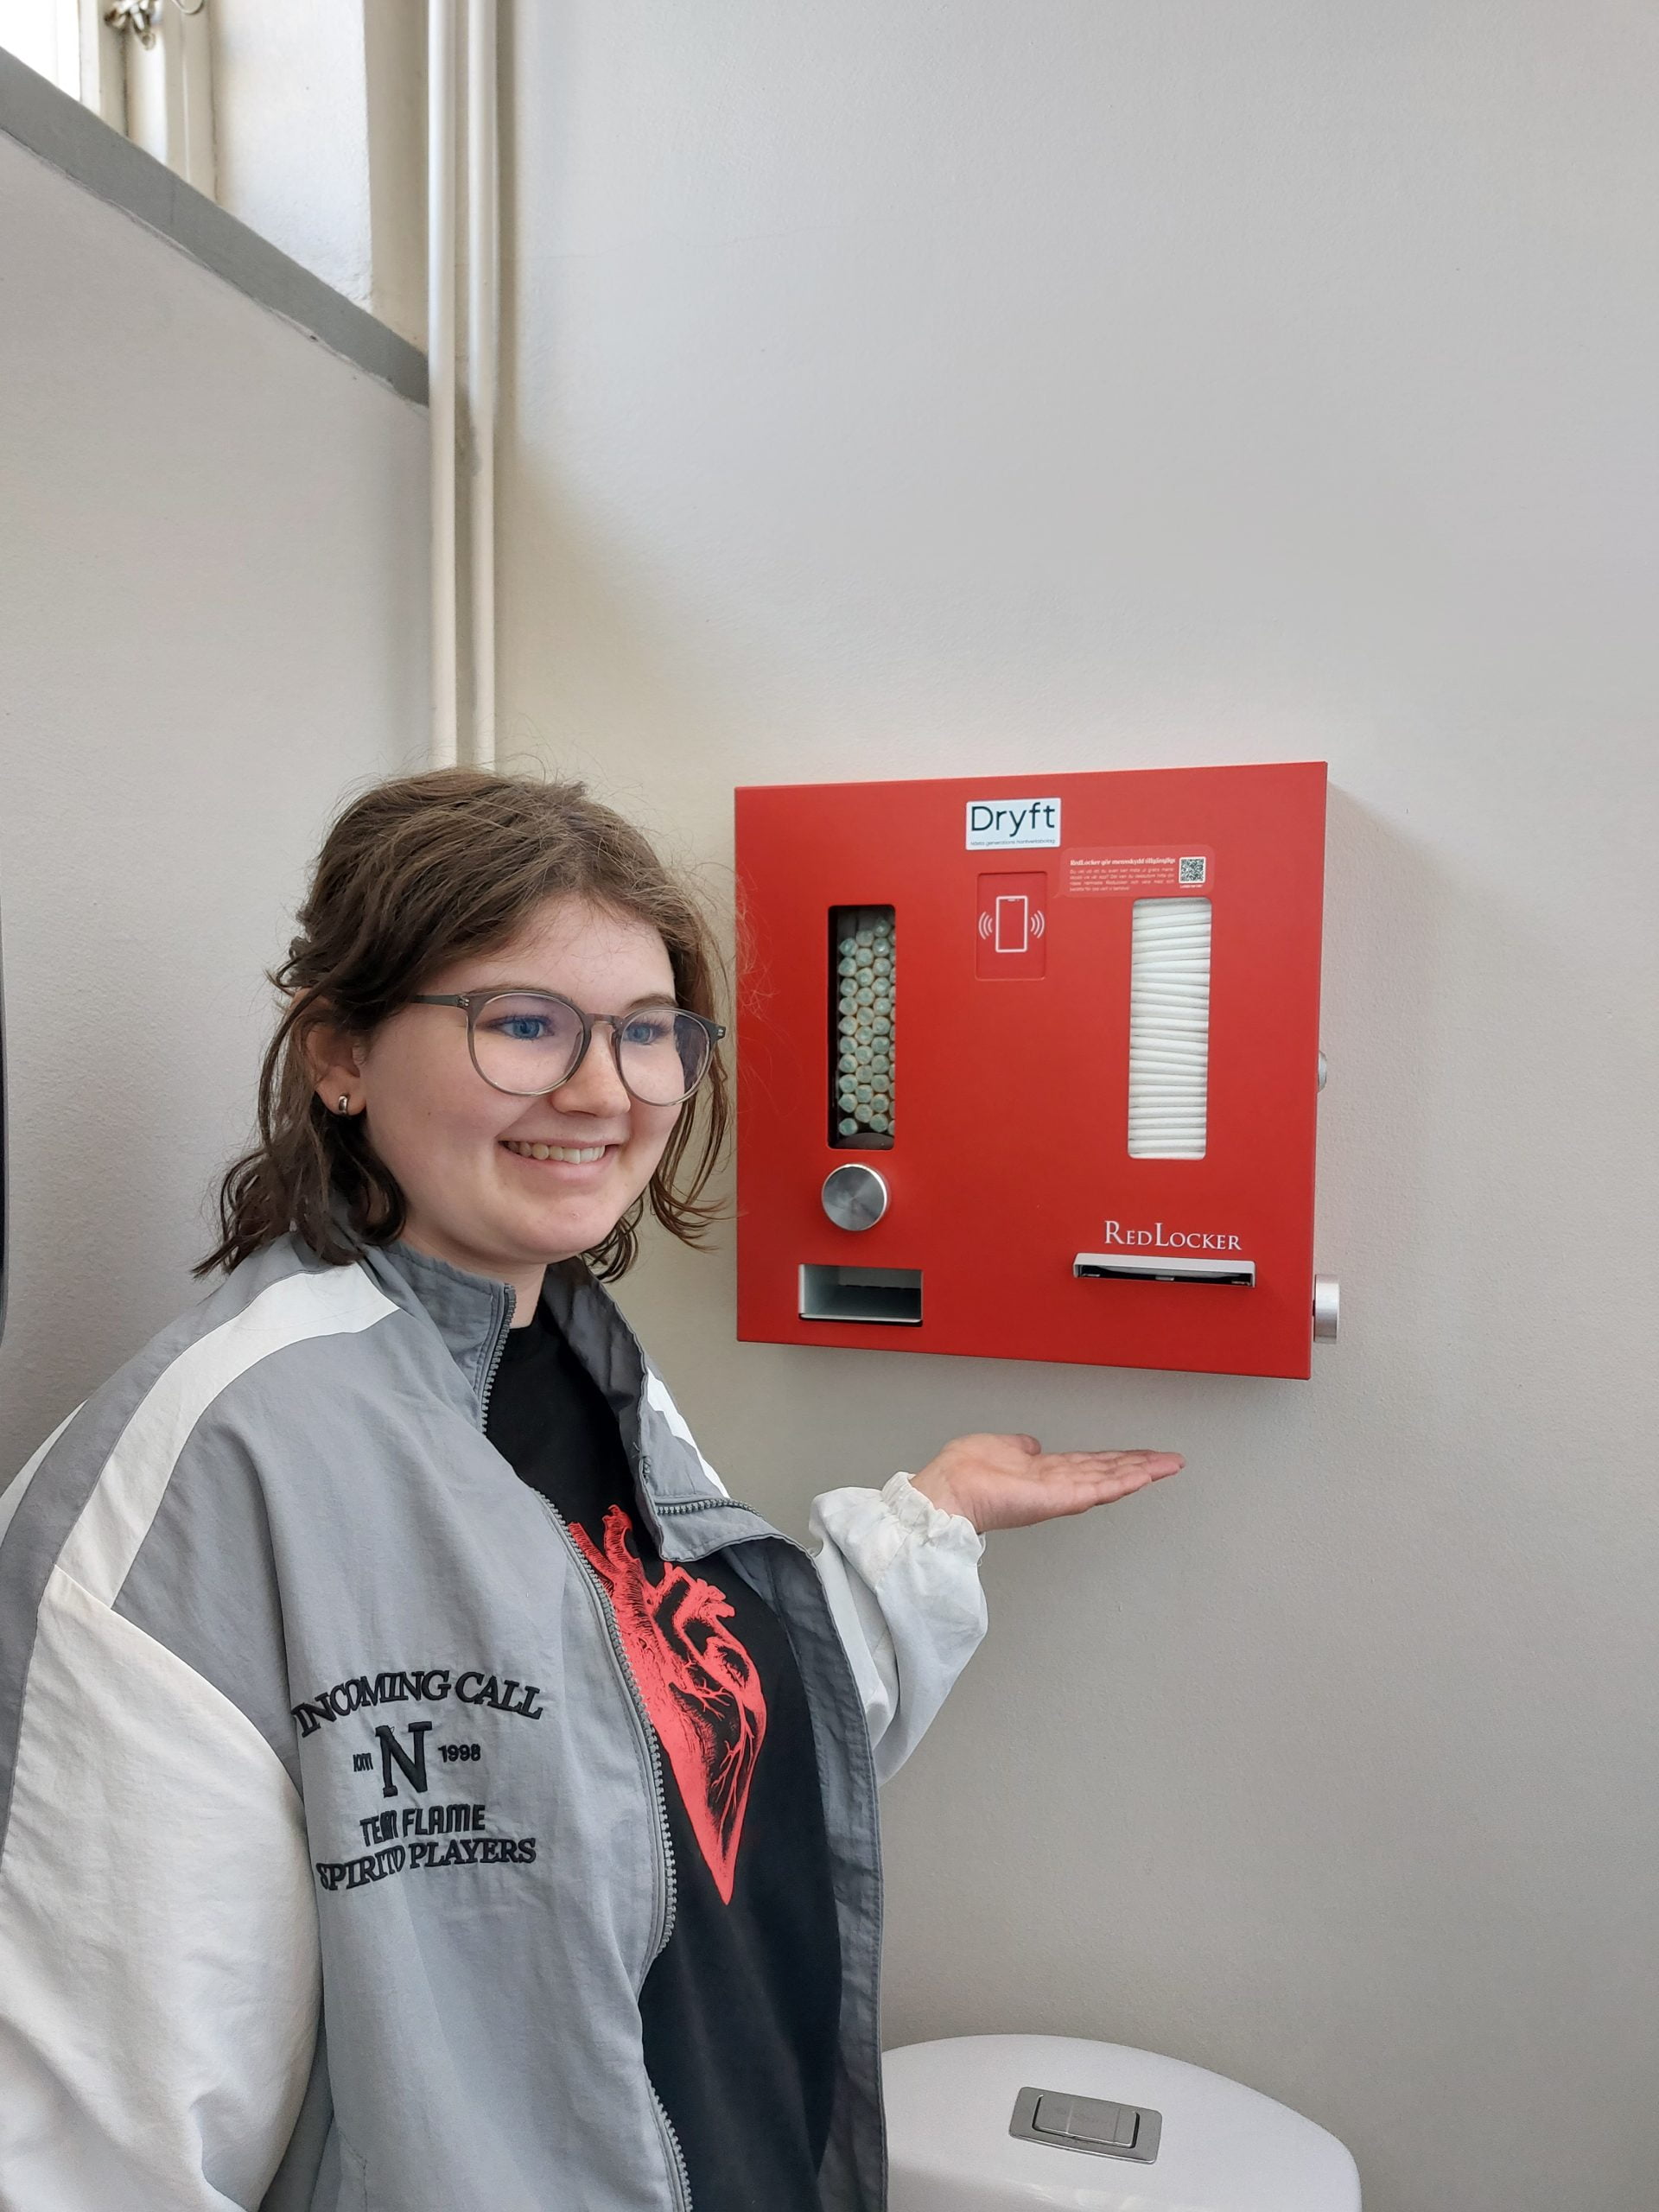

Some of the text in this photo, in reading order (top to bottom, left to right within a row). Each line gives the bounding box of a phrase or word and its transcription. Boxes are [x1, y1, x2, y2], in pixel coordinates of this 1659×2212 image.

[971, 801, 1056, 838] Dryft
[290, 1669, 543, 1738] INCOMING CALL
[374, 1720, 433, 1798] N
[437, 1743, 481, 1764] 1998
[402, 1803, 486, 1839] FLAME
[407, 1836, 537, 1870] PLAYERS
